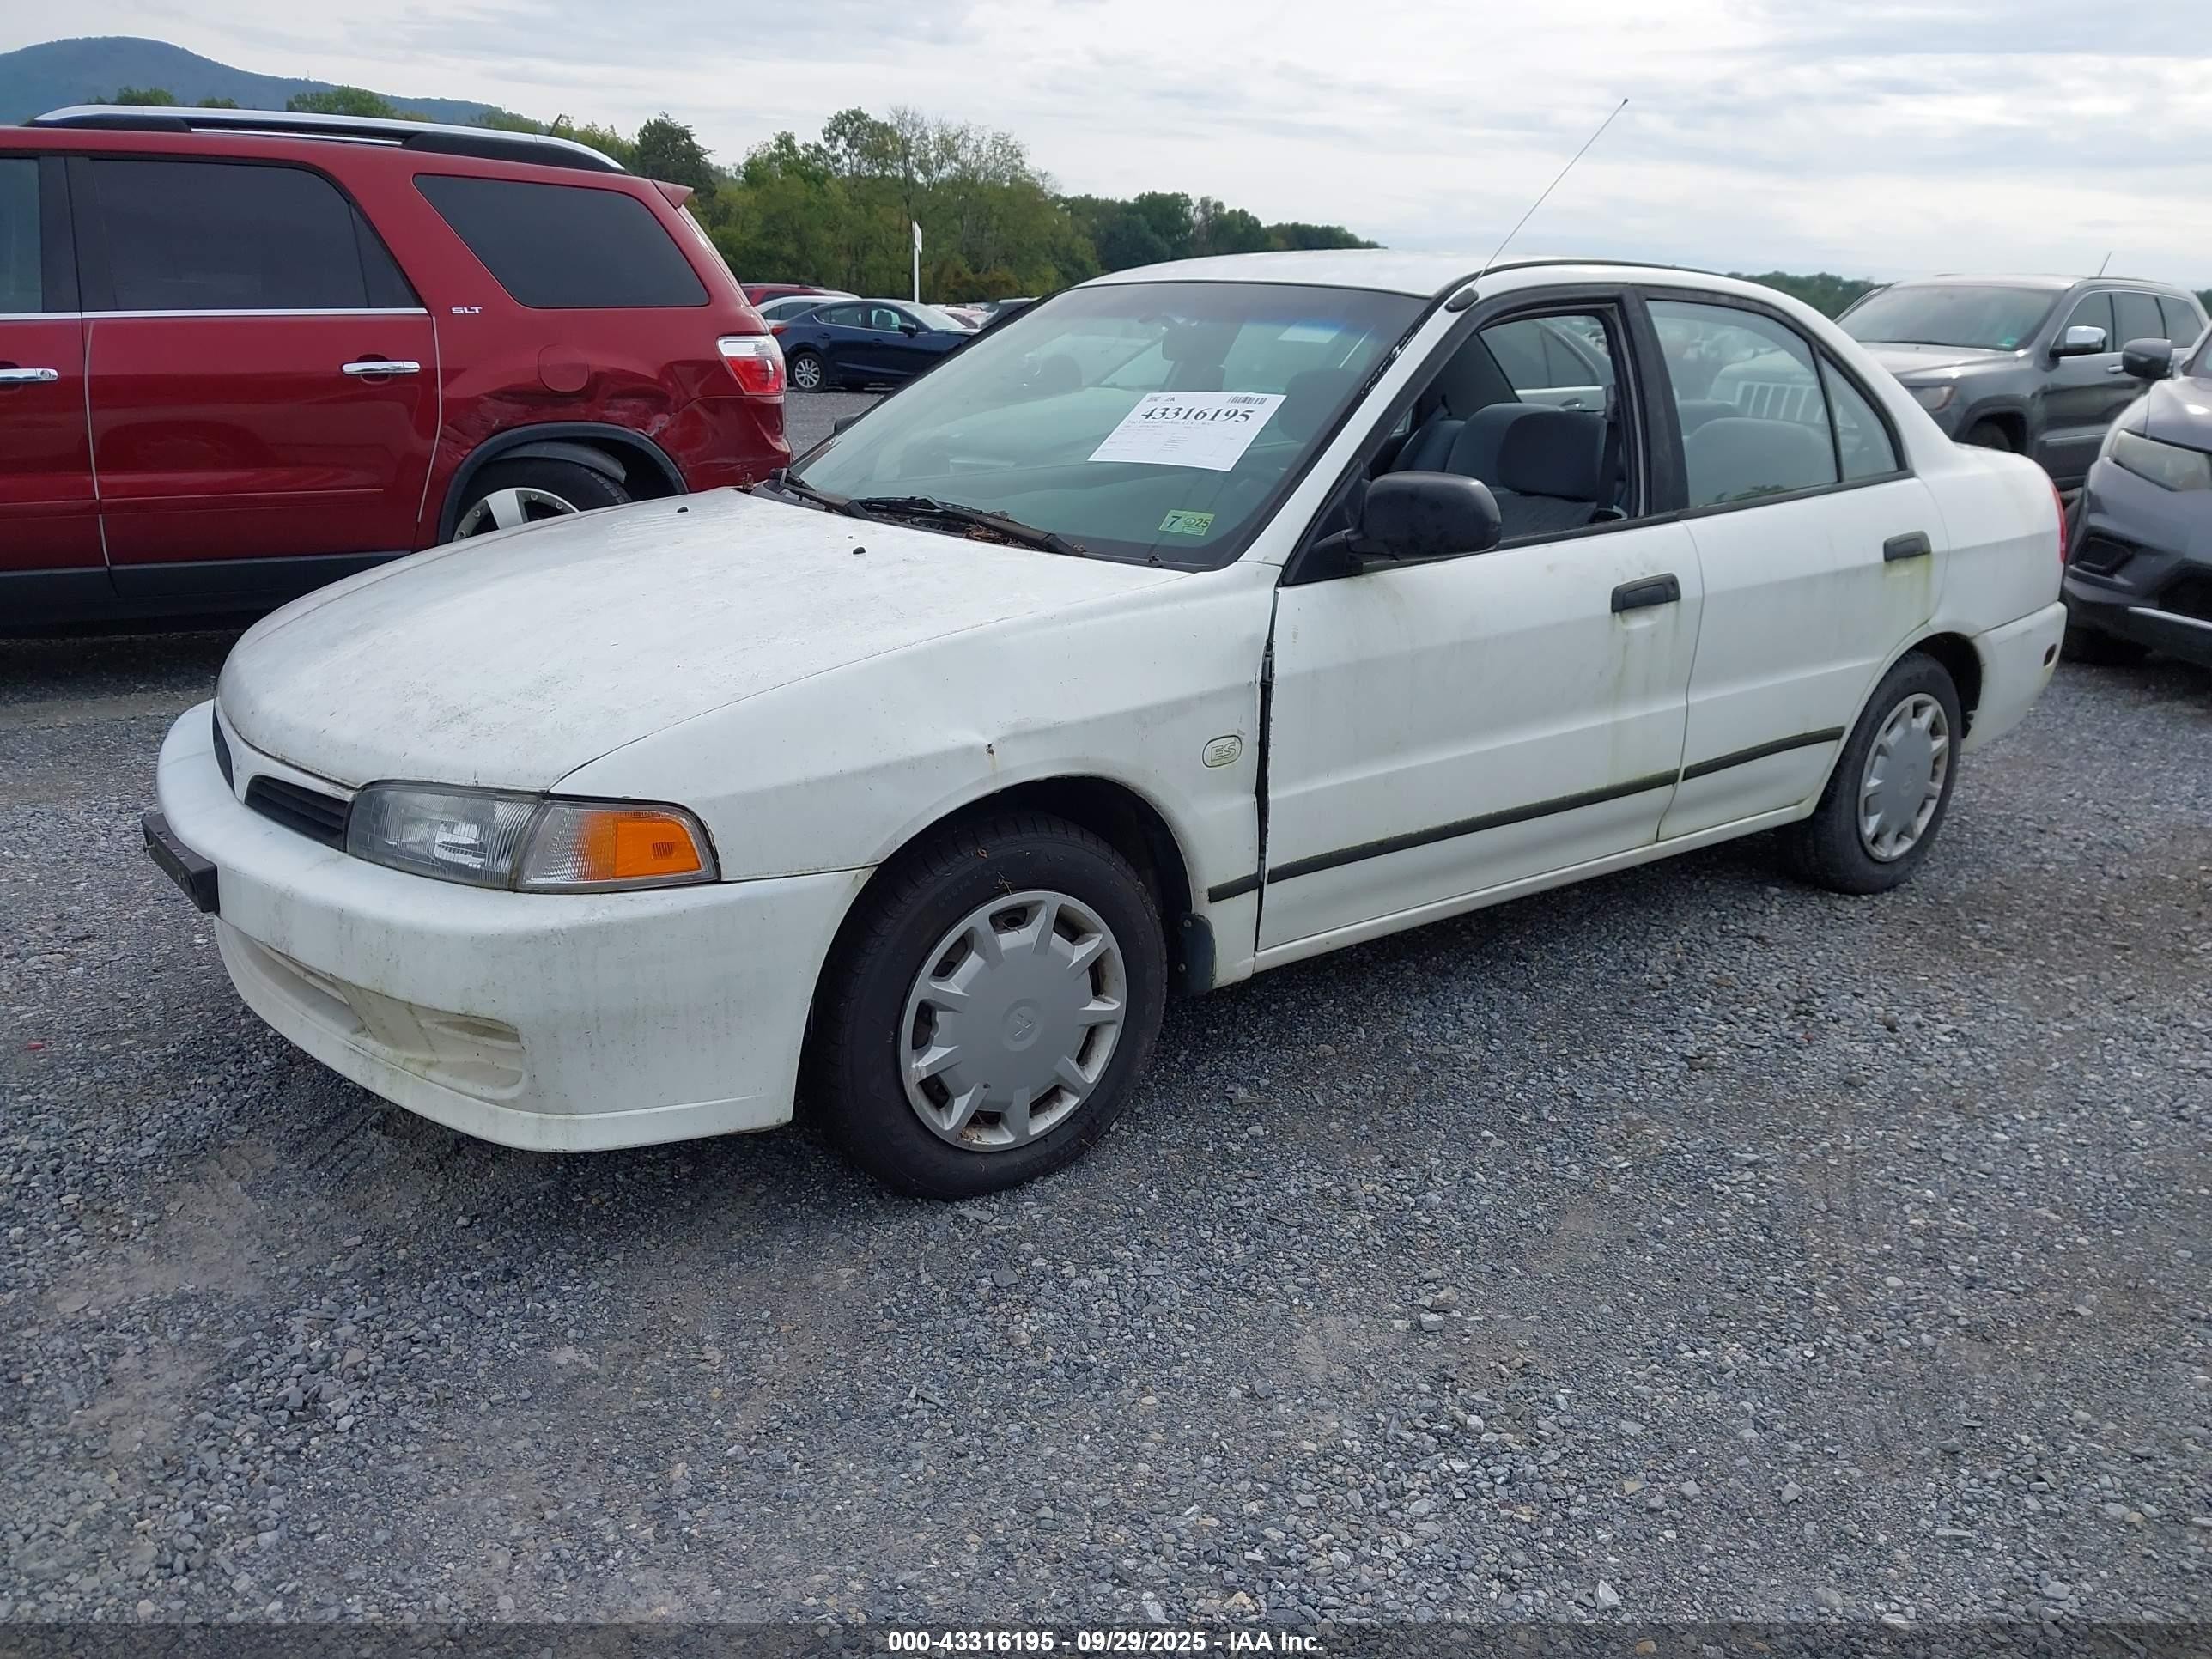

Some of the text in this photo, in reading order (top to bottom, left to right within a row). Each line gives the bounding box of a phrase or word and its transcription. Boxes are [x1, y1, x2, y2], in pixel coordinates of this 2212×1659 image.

[1140, 407, 1255, 422] 43316195
[1167, 515, 1211, 528] 7 25
[1210, 742, 1237, 762] ES
